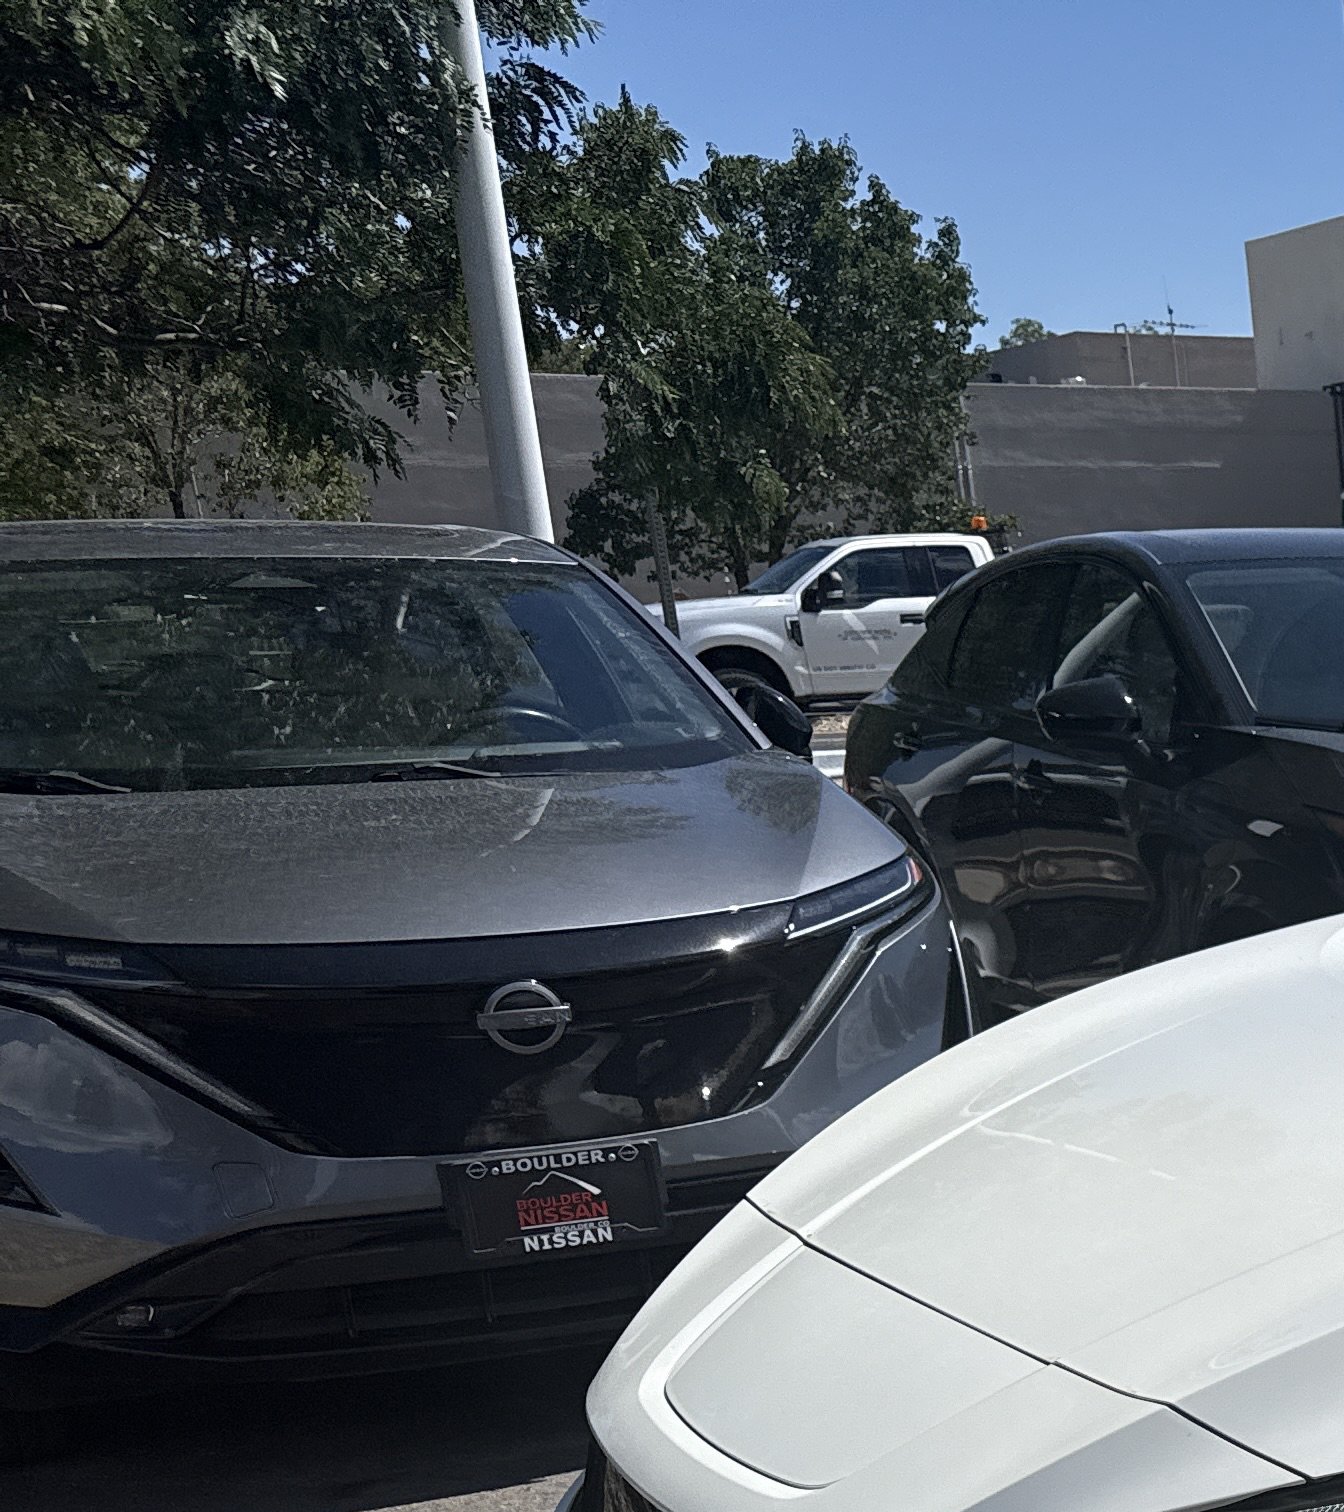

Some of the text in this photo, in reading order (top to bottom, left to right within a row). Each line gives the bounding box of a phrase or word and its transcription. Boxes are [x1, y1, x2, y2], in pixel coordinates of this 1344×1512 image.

[501, 1149, 606, 1174] BOULDER
[516, 1191, 593, 1211] BOULDER
[518, 1201, 609, 1227] NISSAN
[523, 1226, 613, 1253] NISSAN
